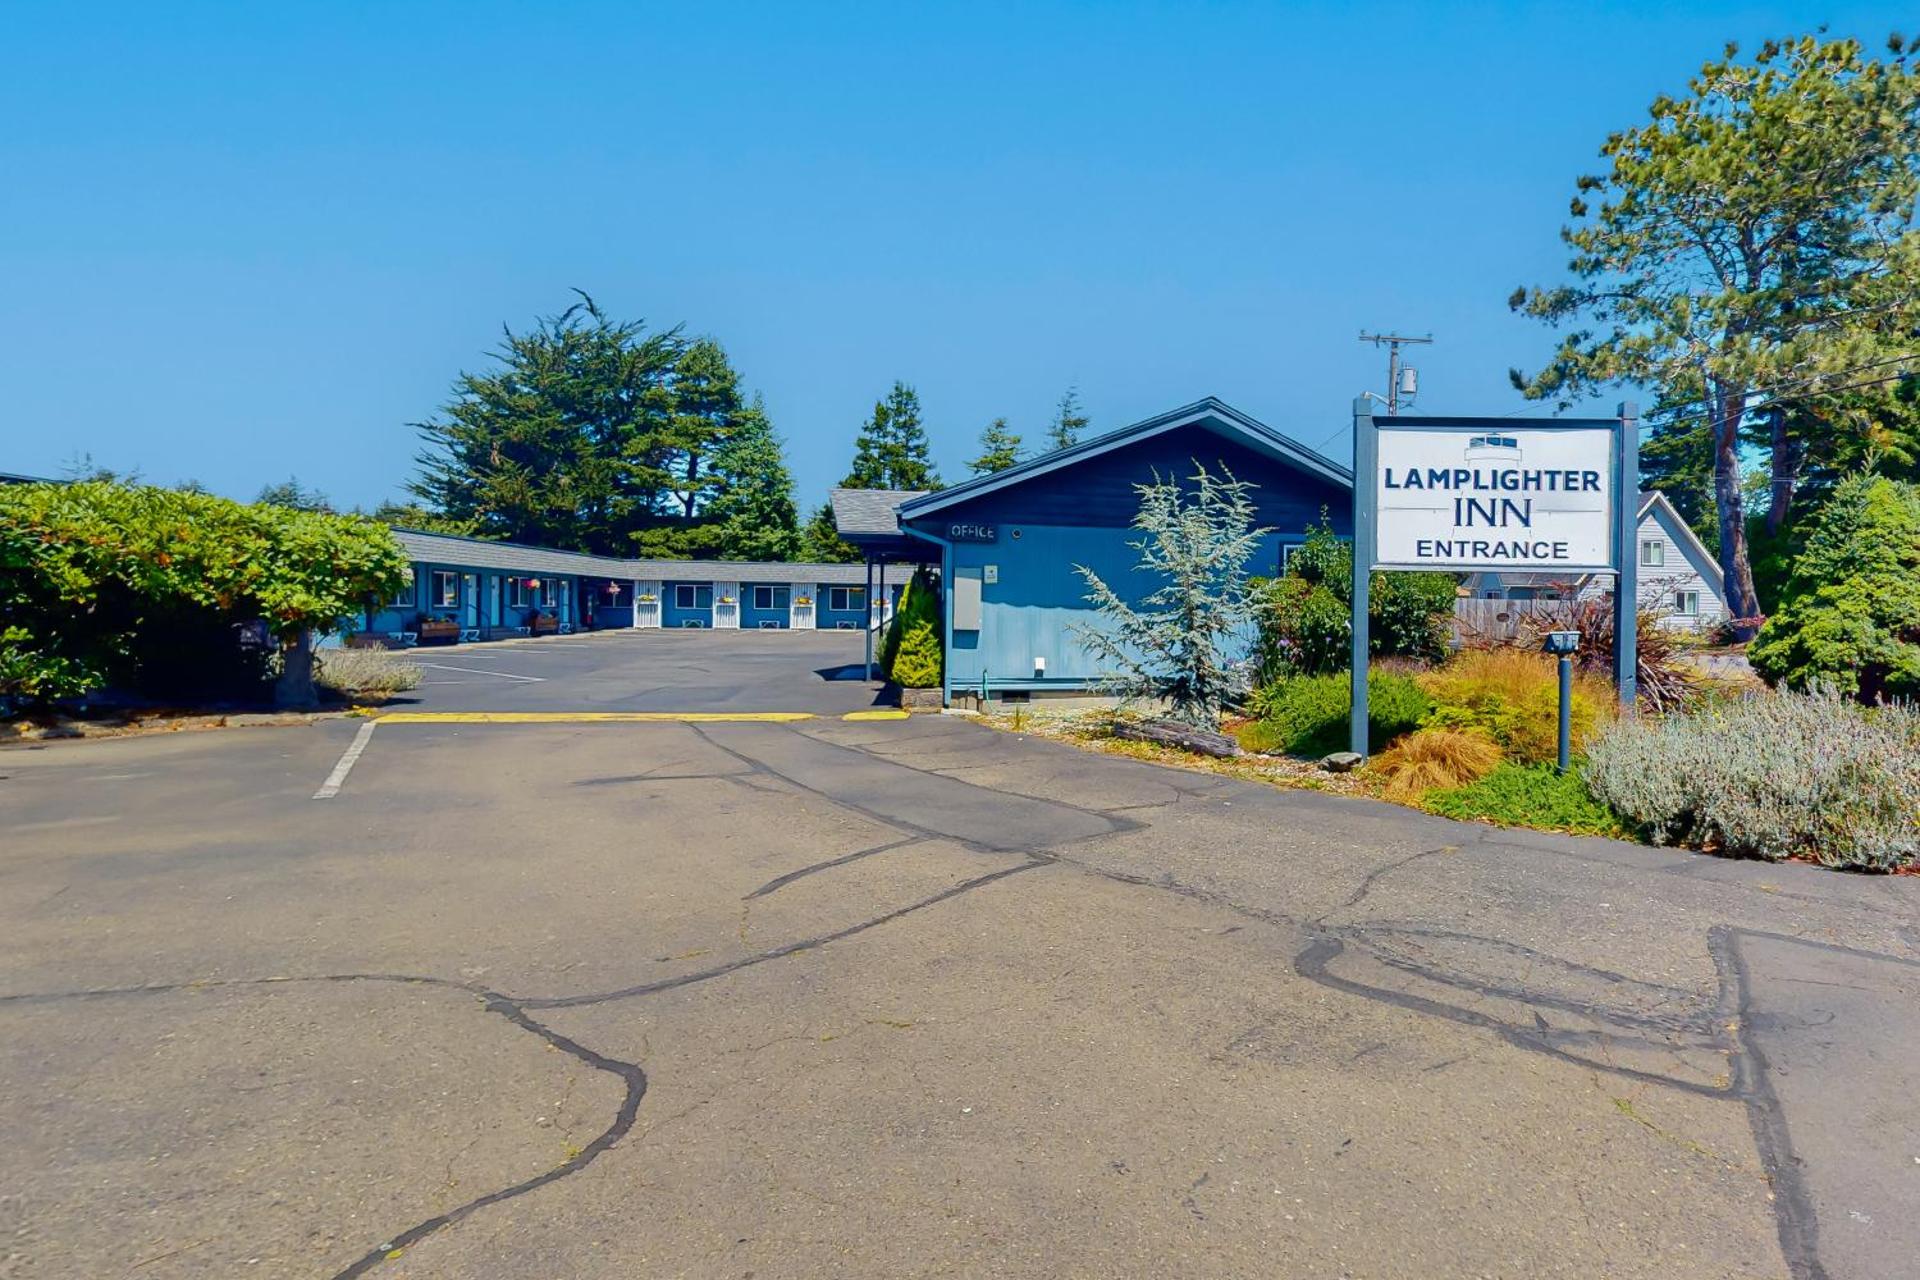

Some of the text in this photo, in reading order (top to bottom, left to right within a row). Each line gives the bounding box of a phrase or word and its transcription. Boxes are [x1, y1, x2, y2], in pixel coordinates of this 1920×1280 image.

[1385, 468, 1601, 491] LAMPLIGHTER
[1454, 498, 1532, 527] INN
[951, 525, 994, 539] OFFICE
[1416, 540, 1569, 559] ENTRANCE
